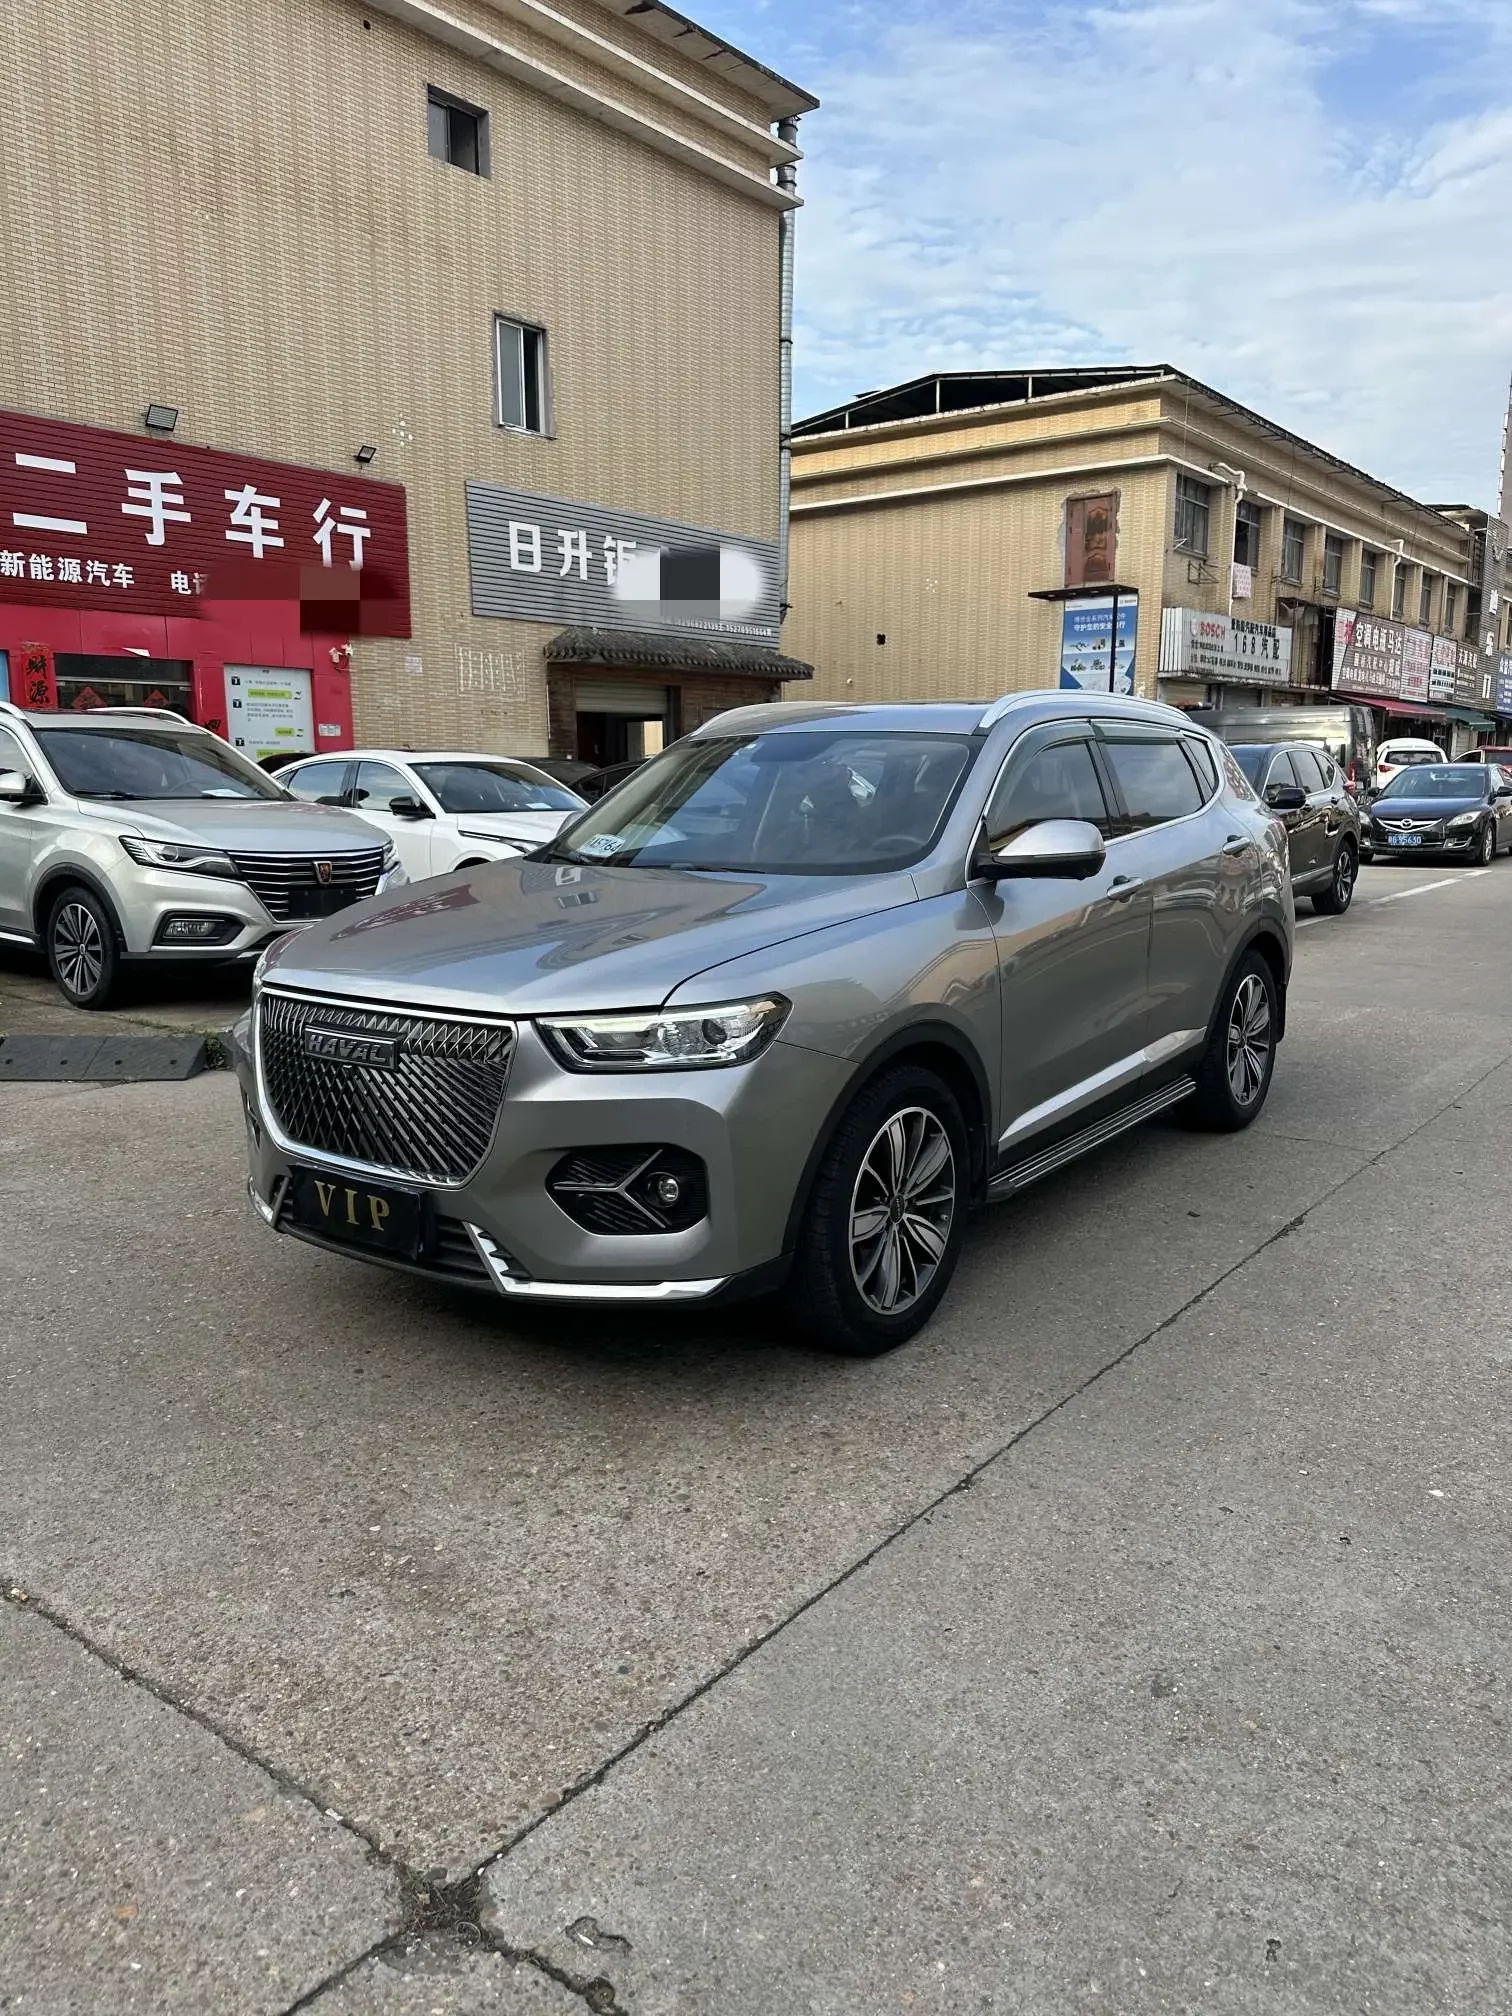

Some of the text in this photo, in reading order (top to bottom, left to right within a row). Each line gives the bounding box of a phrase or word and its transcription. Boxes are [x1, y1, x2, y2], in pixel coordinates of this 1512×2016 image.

[12, 452, 372, 570] 二手车行
[0, 550, 135, 589] 新能源汽车
[1073, 620, 1126, 632] 守护您的安全行
[1199, 621, 1226, 640] BOSCH
[307, 1034, 387, 1063] HAVAL
[314, 1179, 390, 1231] VIP
